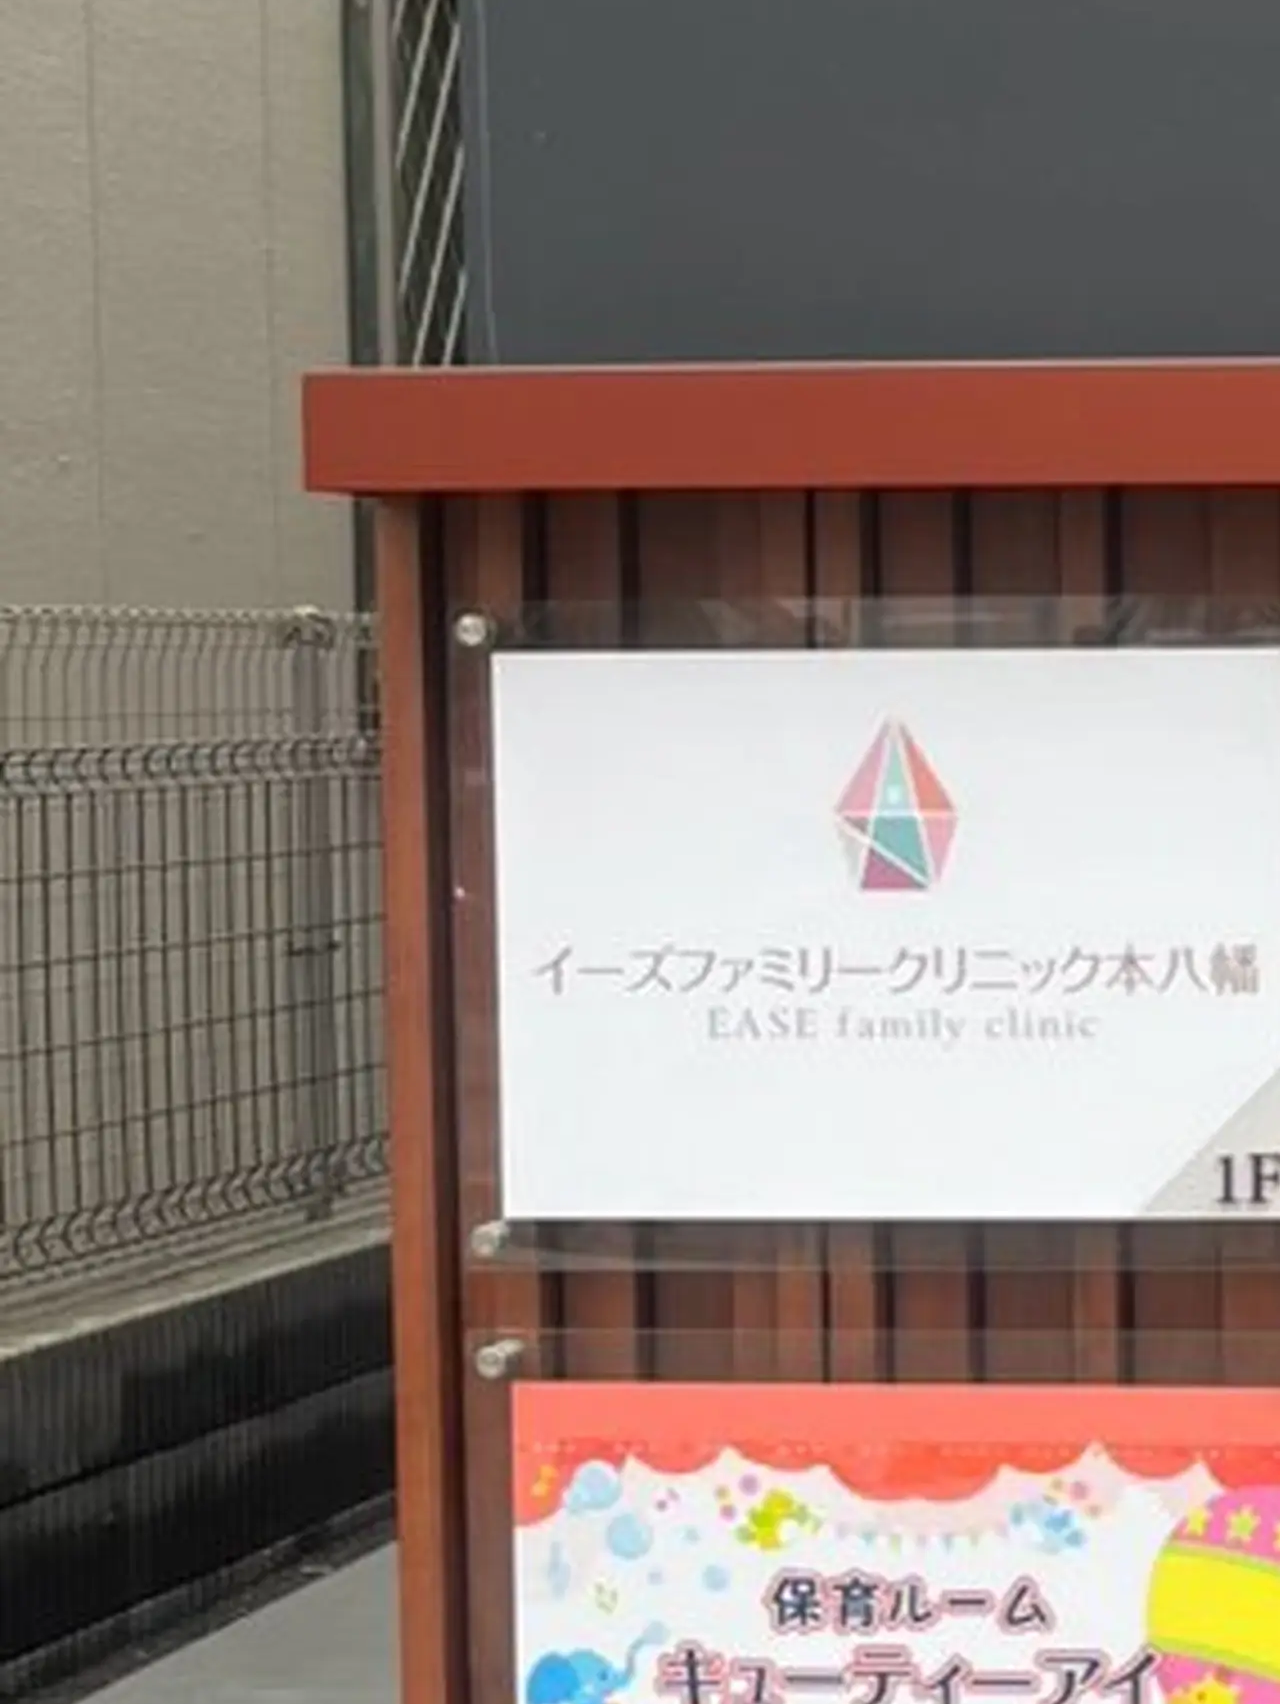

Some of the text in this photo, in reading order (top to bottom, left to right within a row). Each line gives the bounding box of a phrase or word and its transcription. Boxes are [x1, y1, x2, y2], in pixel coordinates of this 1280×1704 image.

[534, 943, 1260, 997] イーズファミリークリニック本八幡
[708, 1006, 1098, 1049] EASE family clinic
[770, 1576, 1049, 1628] 保育ルーム
